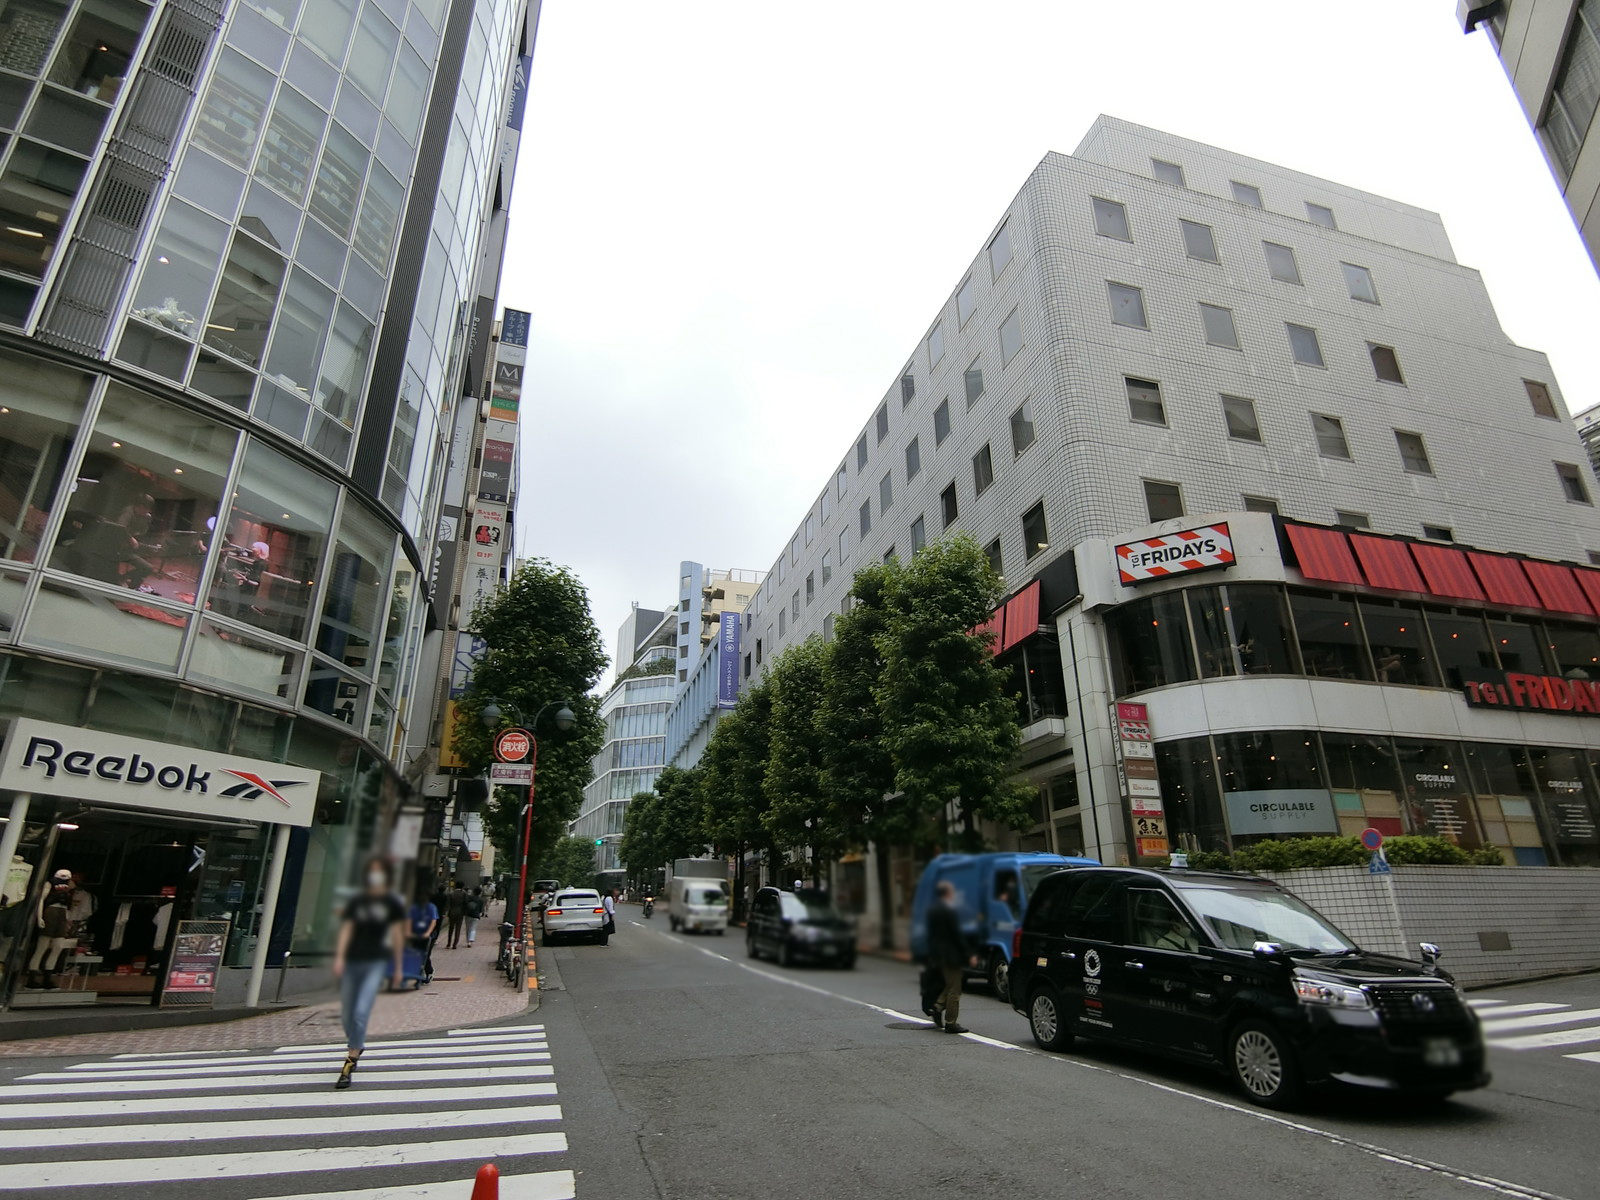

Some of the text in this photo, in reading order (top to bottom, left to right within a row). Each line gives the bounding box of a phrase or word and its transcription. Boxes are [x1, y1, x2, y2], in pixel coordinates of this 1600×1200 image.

[1131, 539, 1217, 568] TGI FRIDAYS
[725, 615, 735, 643] YAMAHA
[1464, 680, 1510, 705] TGI
[502, 742, 527, 752] 消火栓
[20, 735, 211, 793] Reebok
[1415, 773, 1456, 783] CIRCULABLE
[1547, 780, 1584, 789] CIRCULABLE
[1249, 802, 1315, 812] CIRCULABLE
[1261, 812, 1308, 820] SUPPLY
[1137, 817, 1163, 835] 魚民
